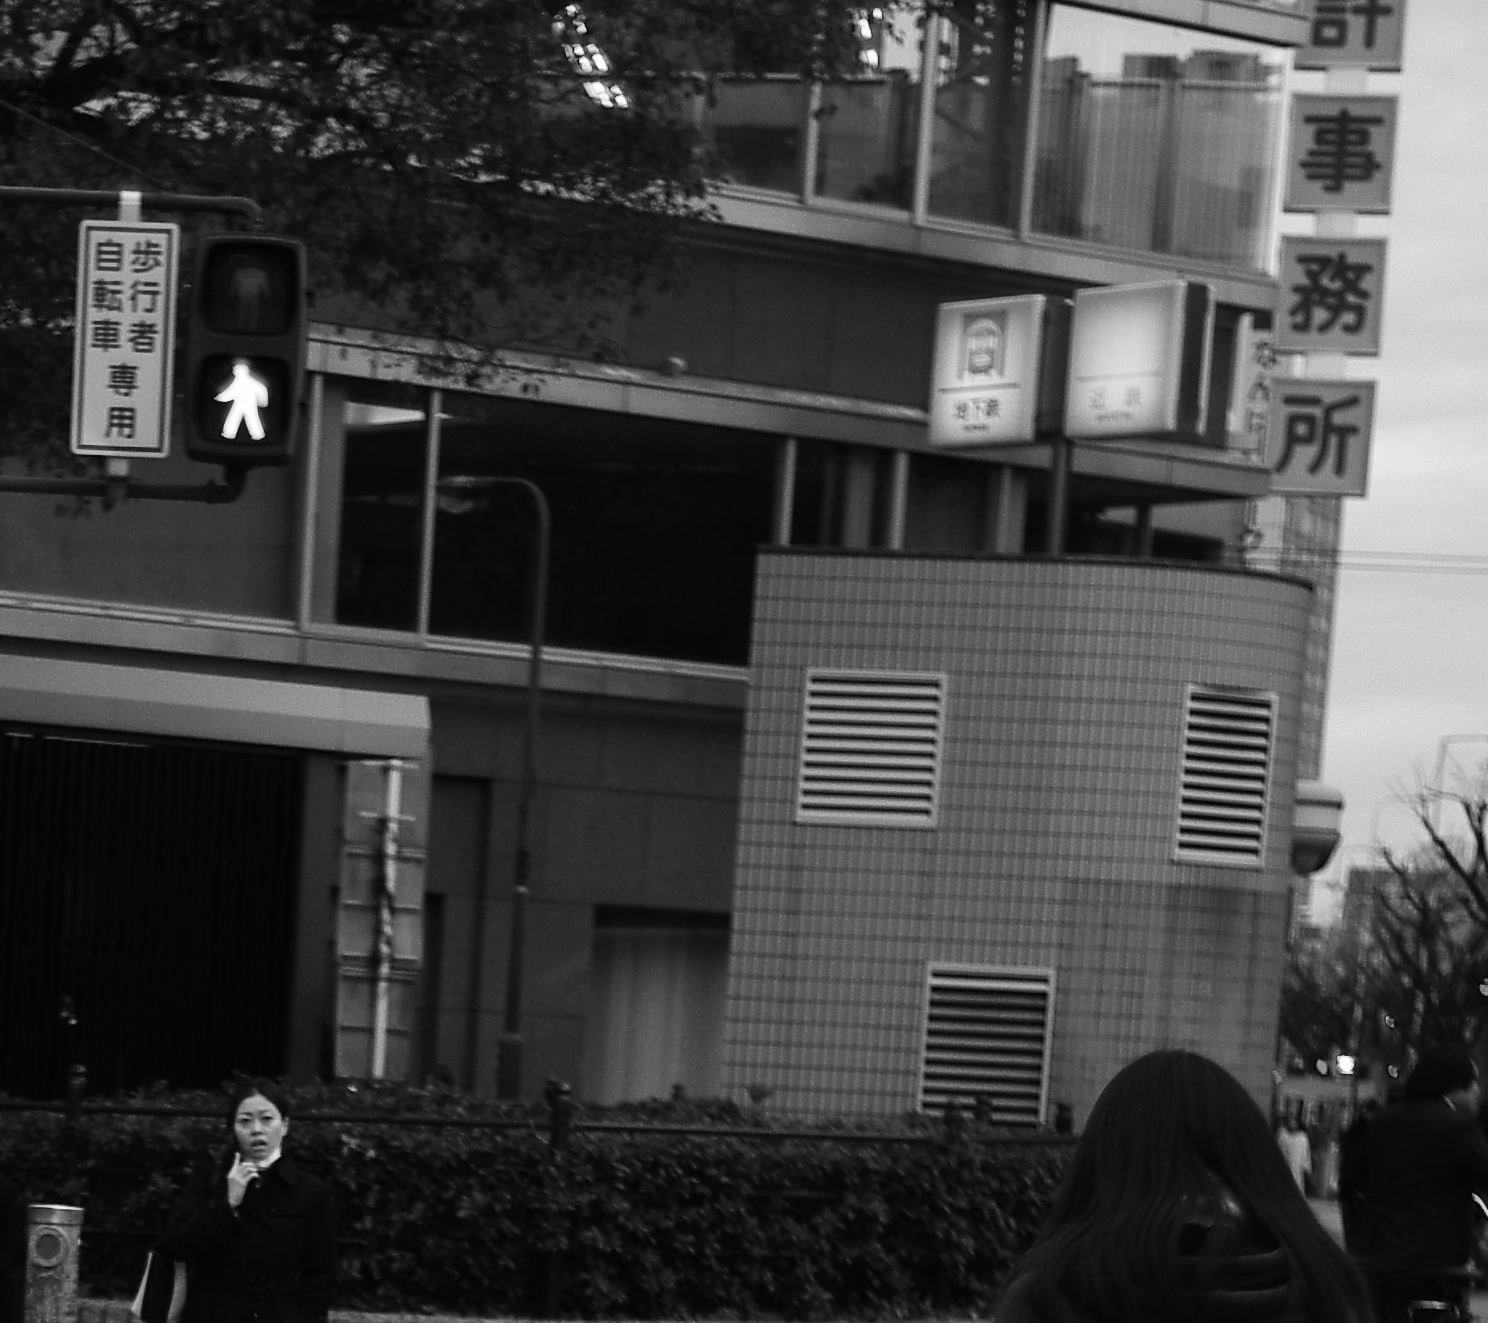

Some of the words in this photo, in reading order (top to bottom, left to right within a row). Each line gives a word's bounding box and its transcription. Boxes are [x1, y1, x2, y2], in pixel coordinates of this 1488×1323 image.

[89, 240, 124, 354] 自転車
[127, 240, 161, 354] 歩行者
[104, 362, 139, 439] 専用
